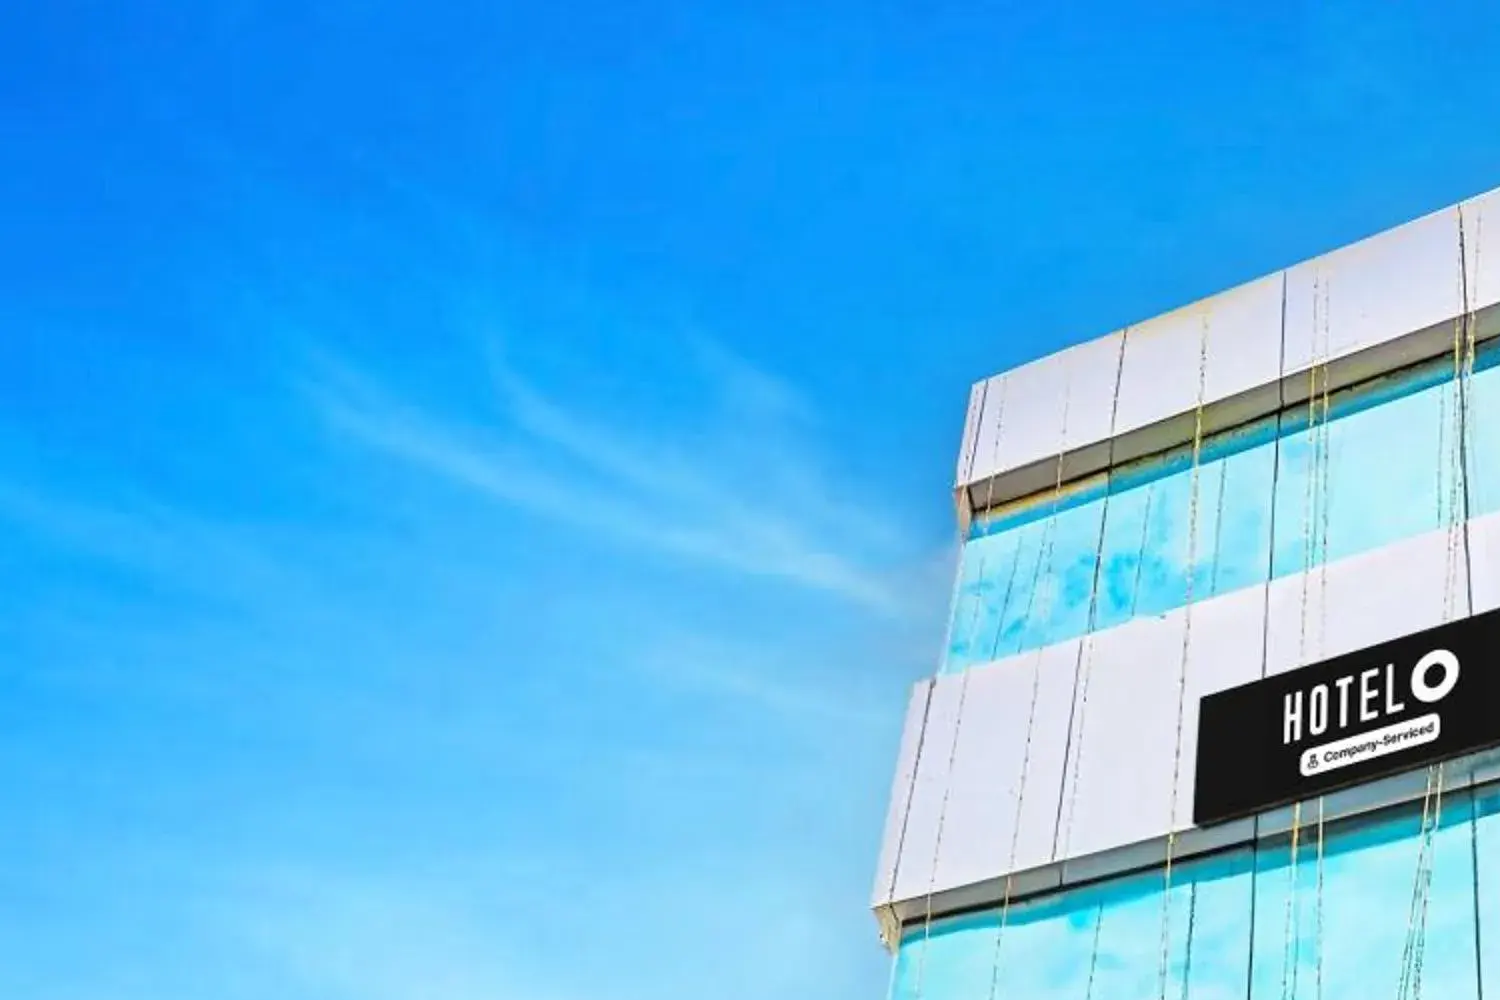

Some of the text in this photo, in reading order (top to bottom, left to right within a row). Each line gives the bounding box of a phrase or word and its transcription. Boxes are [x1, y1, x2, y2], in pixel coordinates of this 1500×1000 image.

[1283, 649, 1460, 744] HOTEL O
[1323, 721, 1435, 763] Company-Serviced
